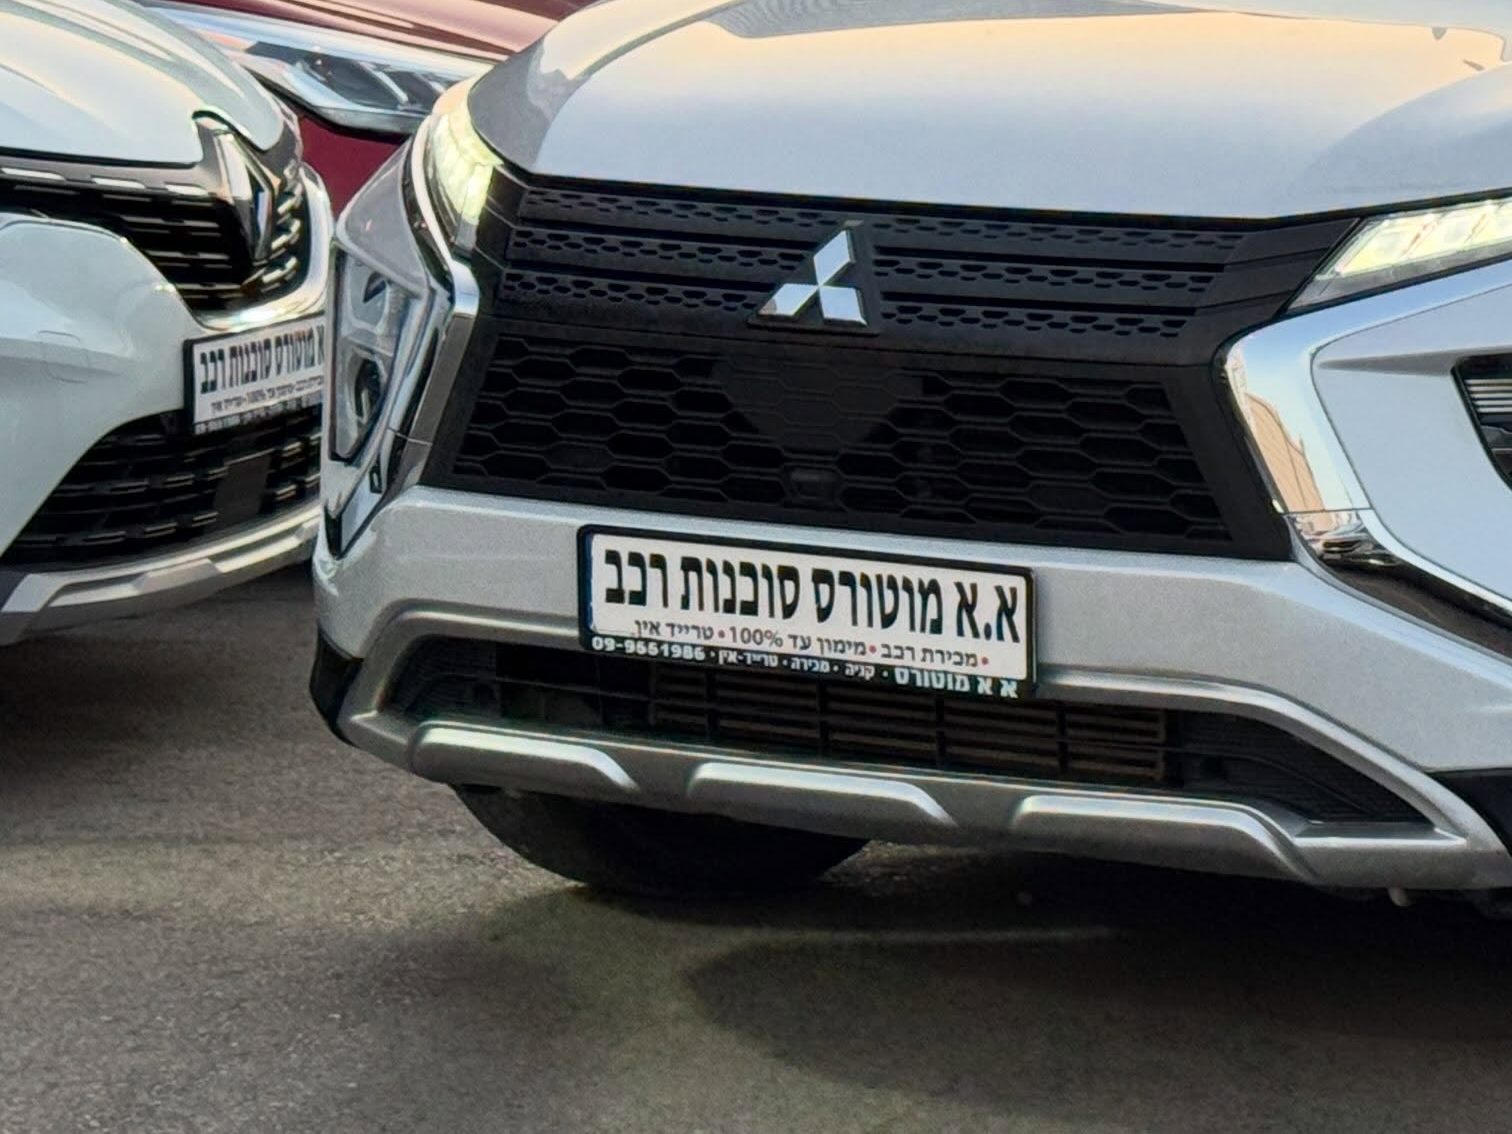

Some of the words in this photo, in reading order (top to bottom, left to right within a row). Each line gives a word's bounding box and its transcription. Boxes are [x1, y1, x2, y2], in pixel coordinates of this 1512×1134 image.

[200, 348, 226, 394] רכב
[604, 548, 669, 609] רכב
[680, 555, 801, 620] סוכנות
[811, 567, 944, 635] מוטורס
[954, 580, 1021, 644] א.א
[729, 625, 784, 648] 100%
[788, 633, 812, 651] עד
[880, 643, 916, 662] רכב
[894, 666, 971, 693] מוטורס
